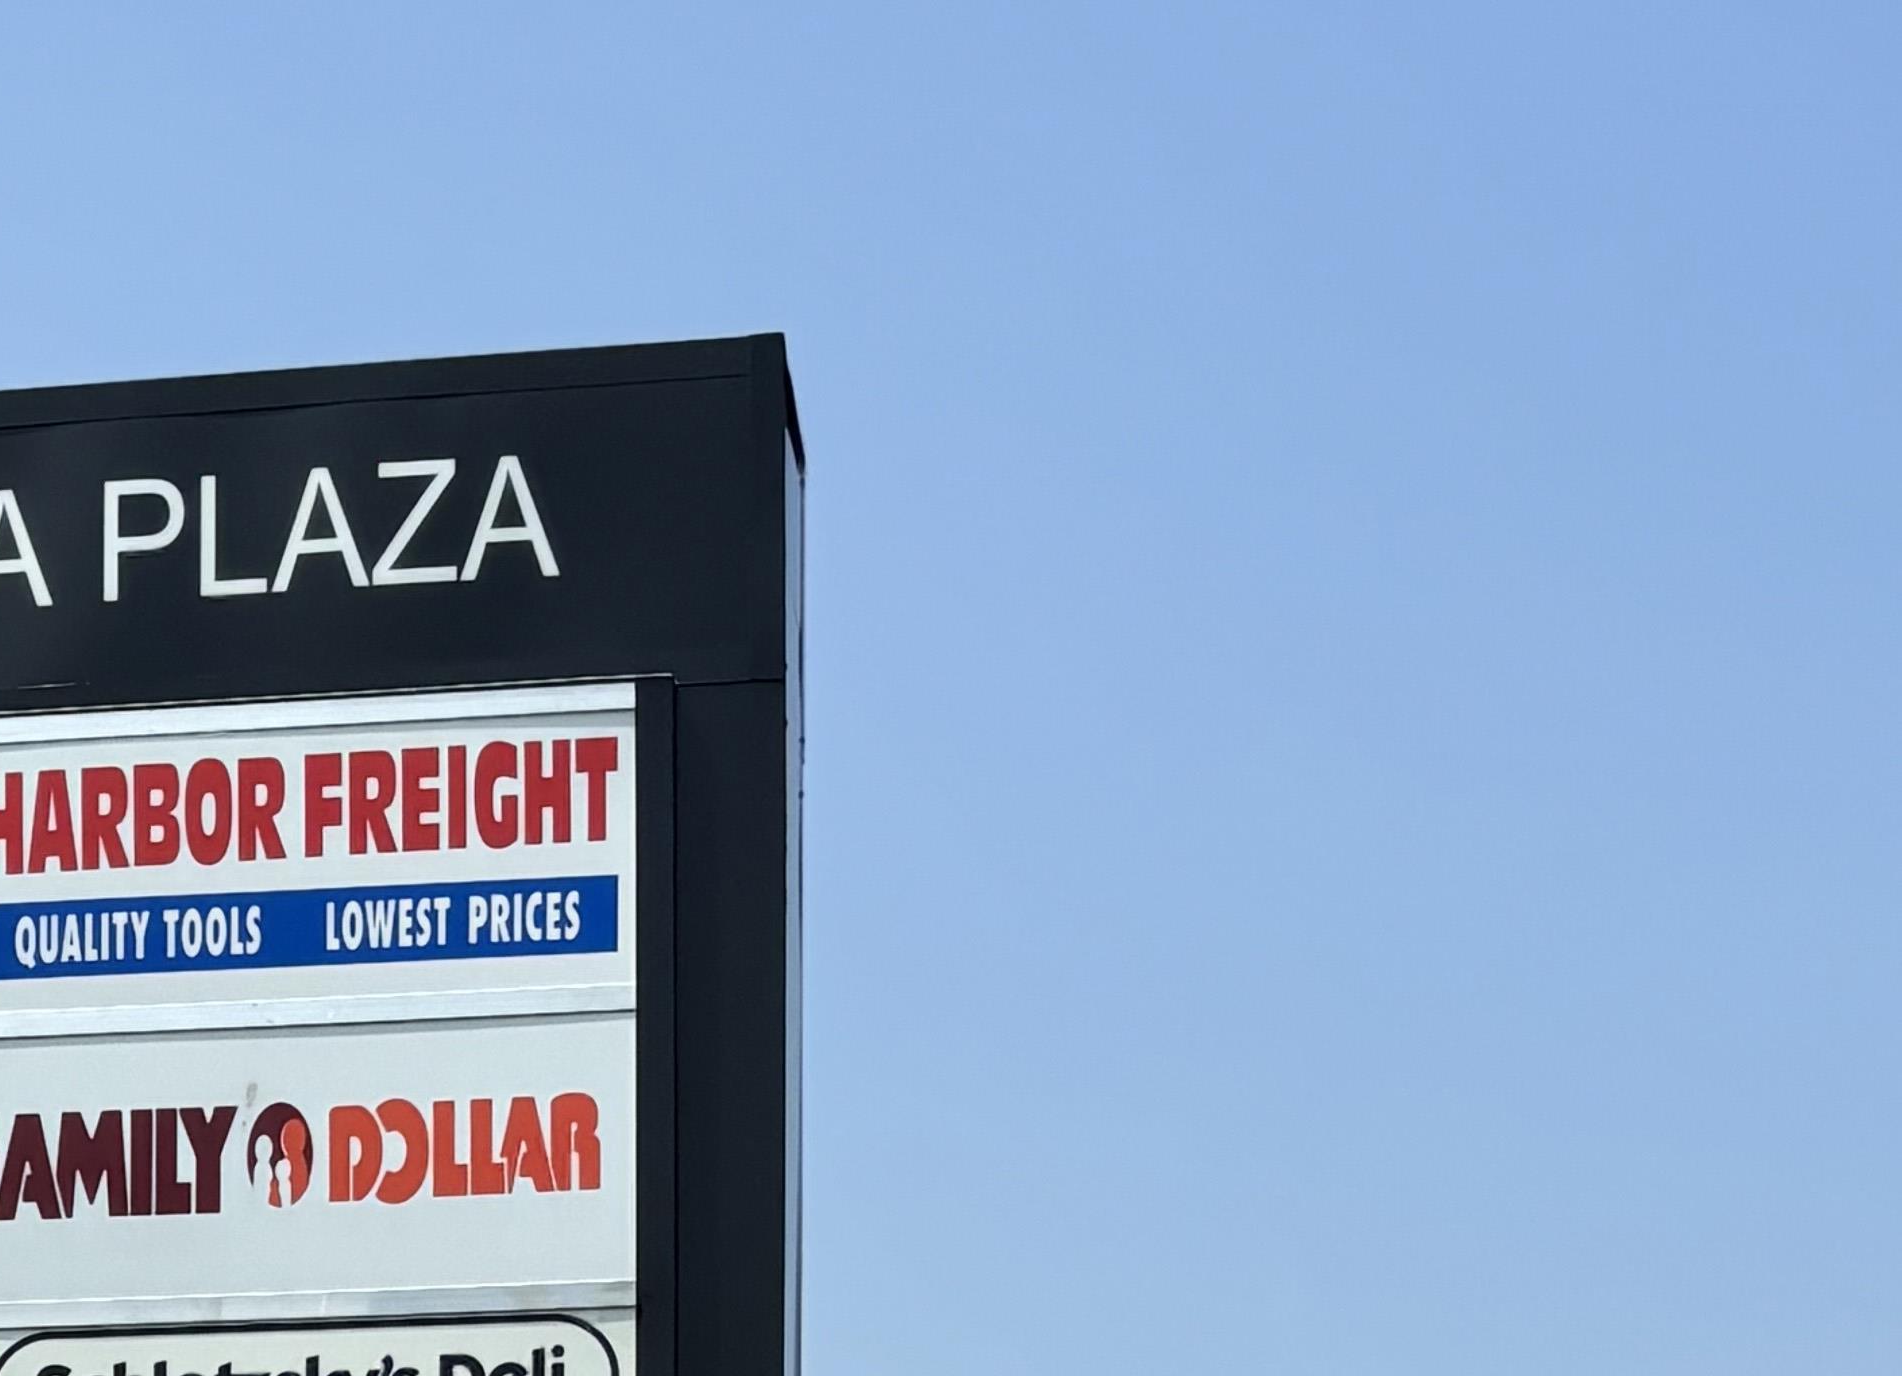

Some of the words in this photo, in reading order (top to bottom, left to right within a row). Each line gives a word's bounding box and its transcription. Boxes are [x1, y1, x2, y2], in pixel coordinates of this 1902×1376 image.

[100, 453, 562, 603] PLAZA
[303, 736, 619, 858] FREIGHT
[13, 909, 151, 968] QUALITY
[162, 904, 263, 958] TOOLS
[324, 896, 451, 952] LOWEST
[467, 889, 581, 944] PRICES
[328, 1091, 601, 1206] DOLLAR
